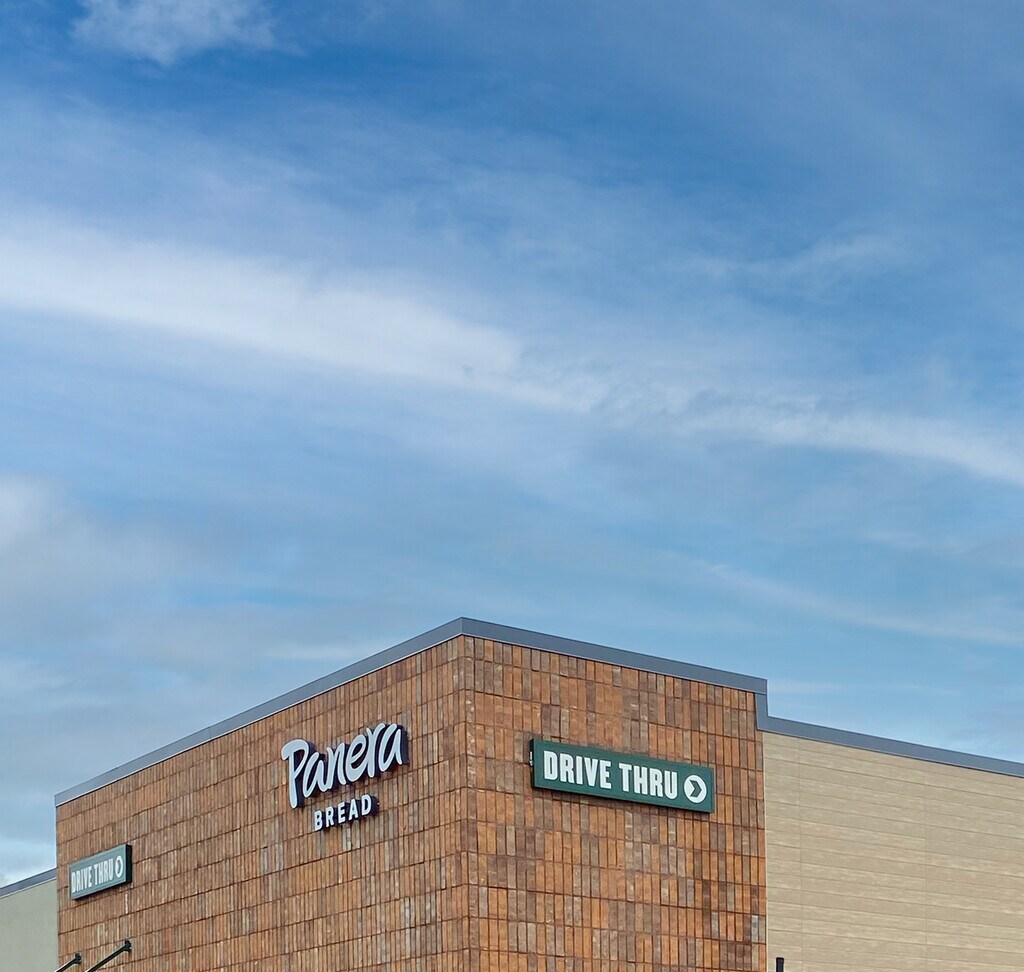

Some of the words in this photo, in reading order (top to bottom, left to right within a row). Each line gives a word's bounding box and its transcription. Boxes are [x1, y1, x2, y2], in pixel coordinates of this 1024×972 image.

[281, 723, 403, 809] Panera
[543, 750, 612, 789] DRIVE
[619, 763, 678, 800] THRU
[314, 794, 372, 831] BREAD
[71, 865, 92, 894] DRIVE
[93, 858, 114, 886] THRU
